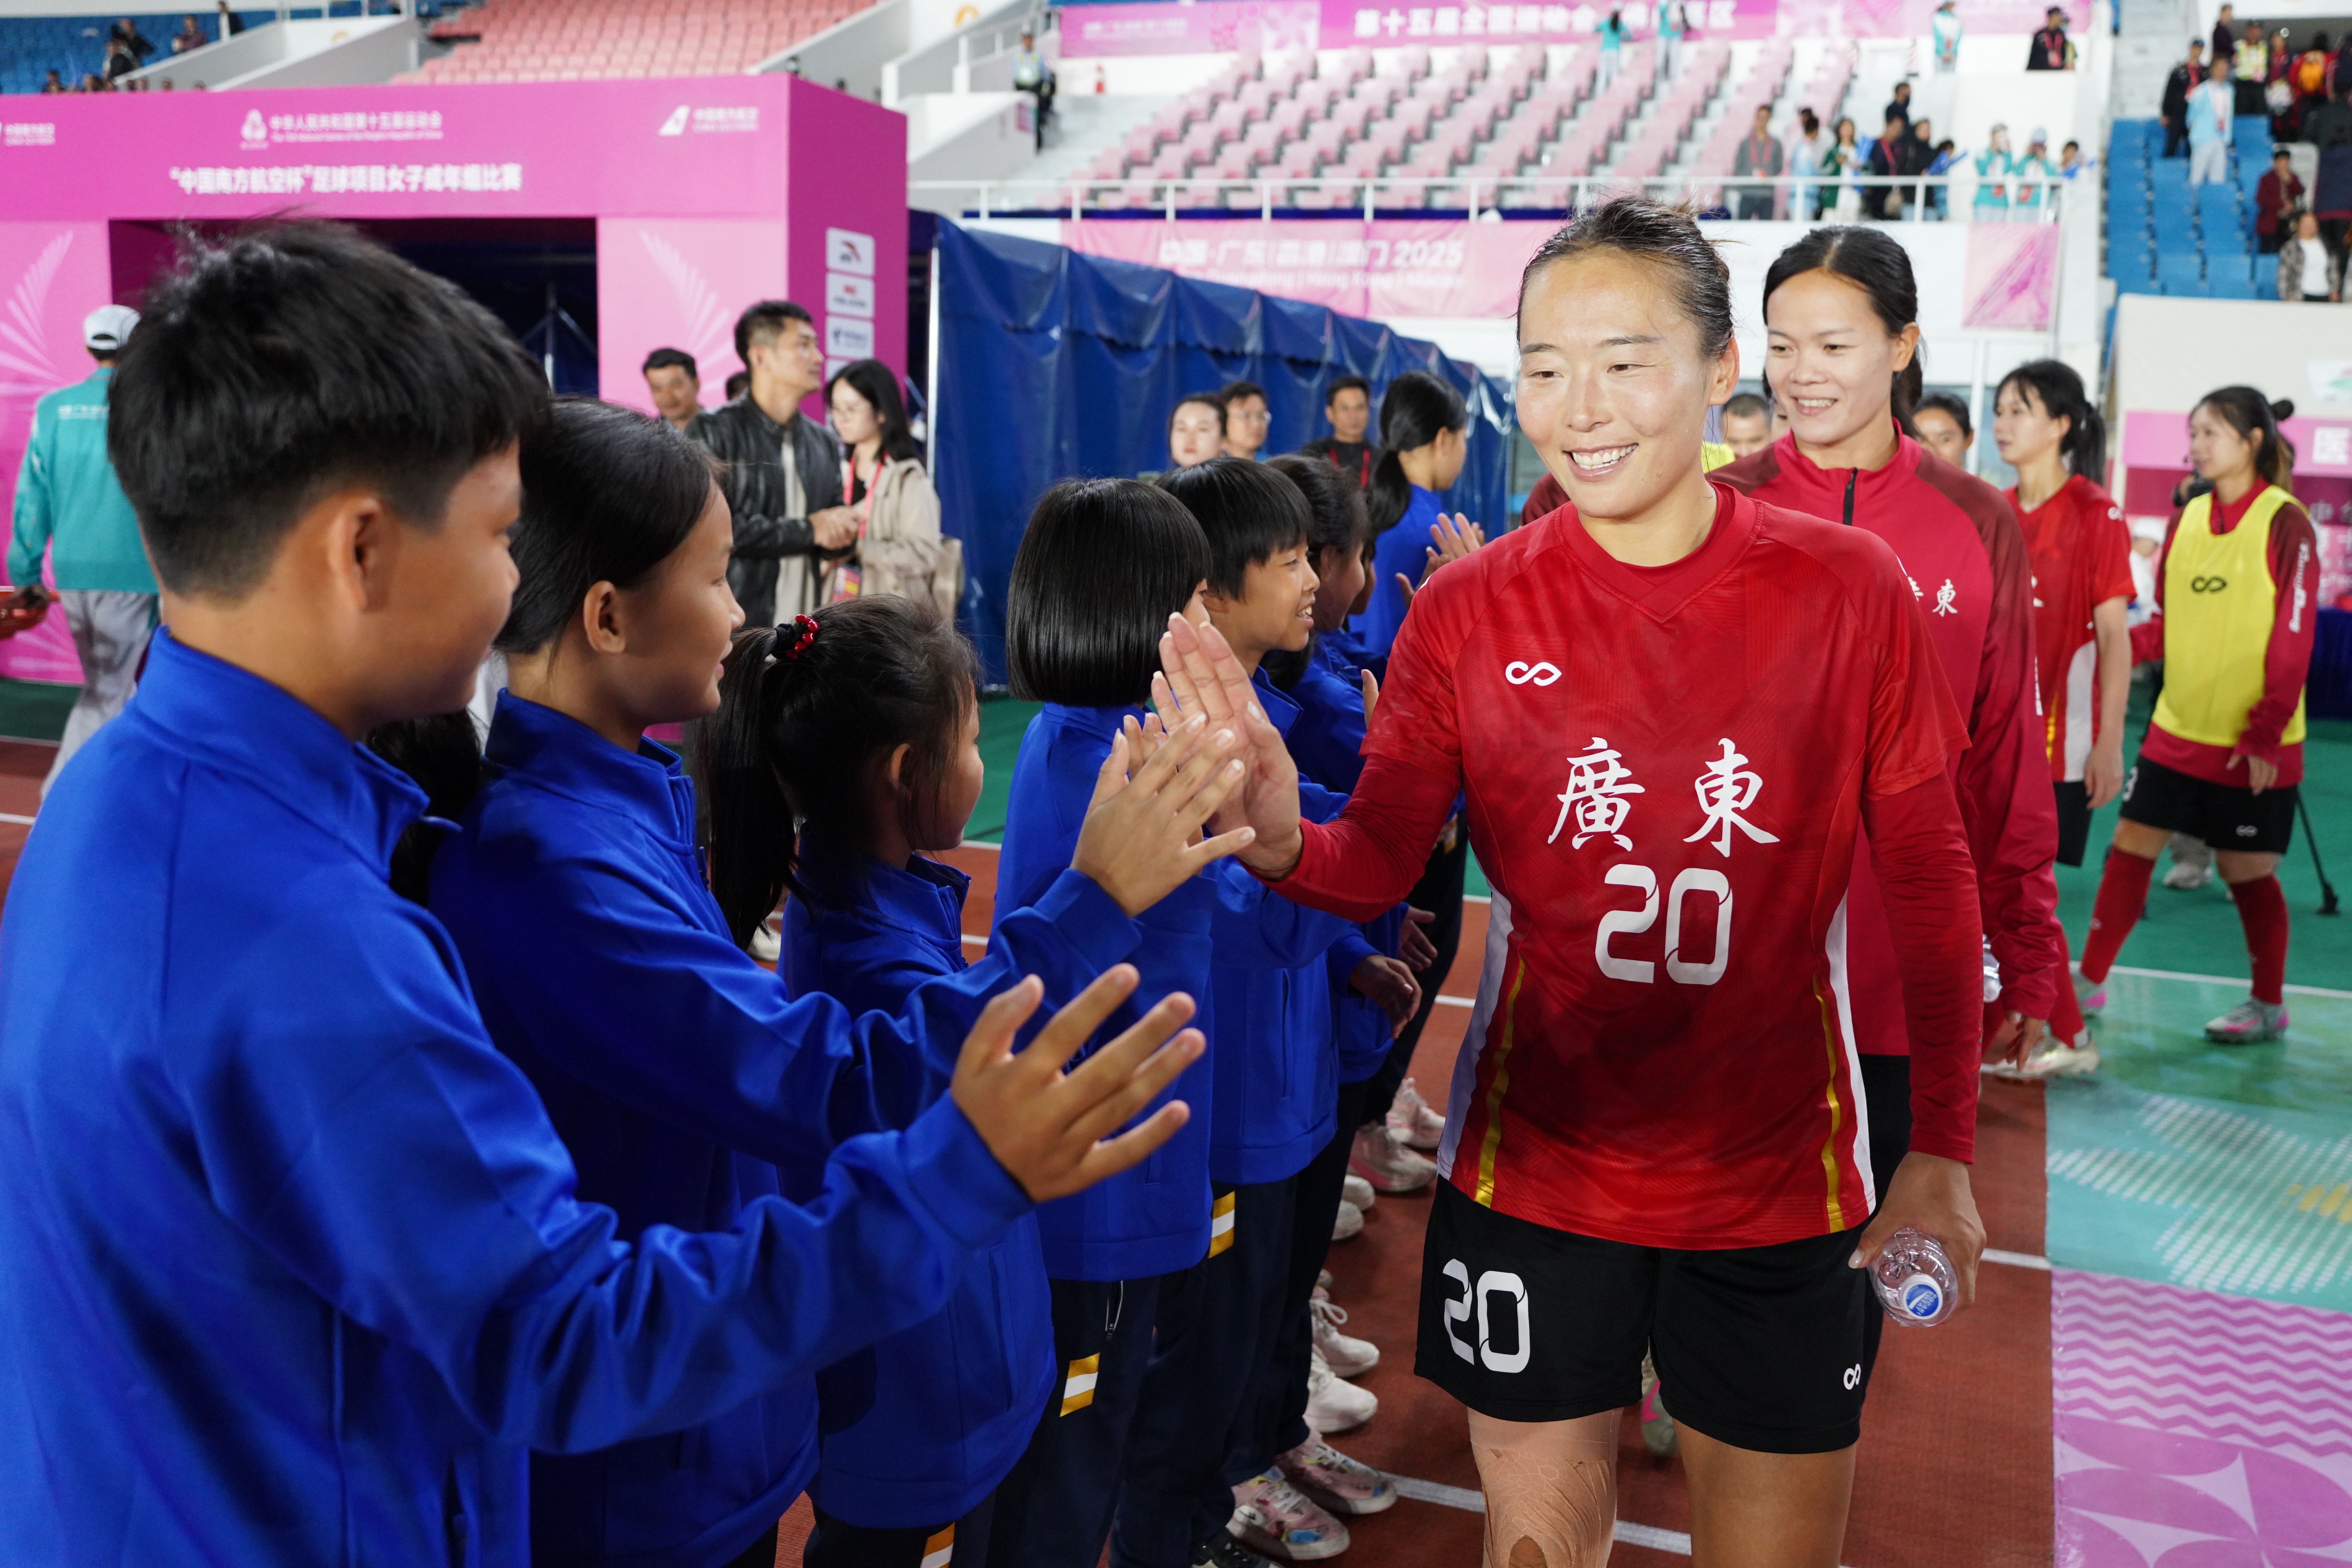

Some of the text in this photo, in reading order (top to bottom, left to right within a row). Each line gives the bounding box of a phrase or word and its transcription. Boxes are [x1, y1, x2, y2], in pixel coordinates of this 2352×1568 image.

[1391, 239, 1463, 268] 2025
[1595, 864, 1733, 985] 20
[1443, 1258, 1531, 1373] 20
